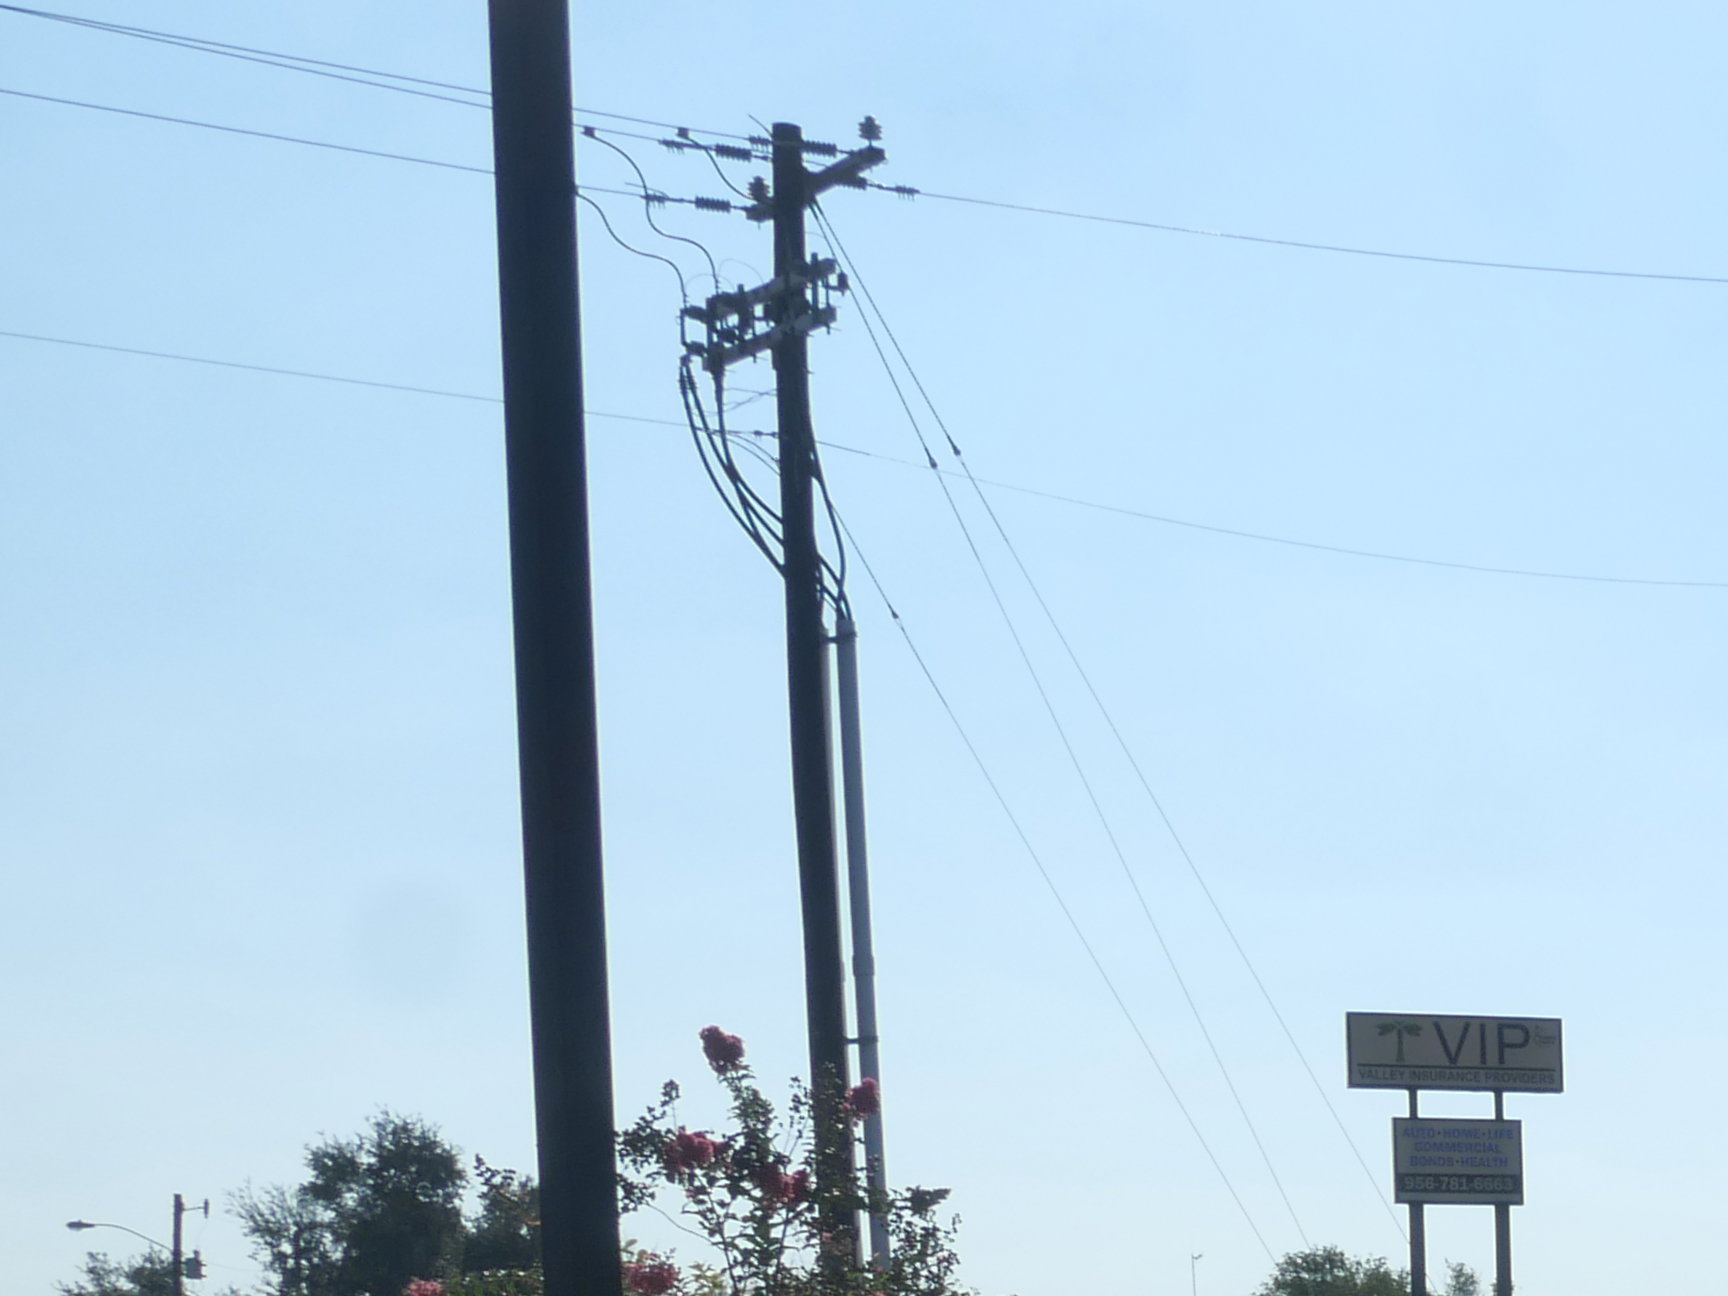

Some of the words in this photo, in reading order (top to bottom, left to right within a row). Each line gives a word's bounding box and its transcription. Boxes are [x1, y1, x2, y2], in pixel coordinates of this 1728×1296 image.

[1432, 1021, 1530, 1065] VIP
[1358, 1069, 1405, 1081] VALLEY
[1409, 1070, 1481, 1083] INSURANCE
[1485, 1072, 1555, 1085] PROVIDERS
[1403, 1127, 1435, 1139] AUTO
[1443, 1128, 1481, 1139] HOME
[1488, 1129, 1514, 1140] LIFE
[1414, 1142, 1501, 1153] COMMERCIAL
[1410, 1156, 1454, 1167] BONDS
[1460, 1156, 1508, 1168] HEALTH
